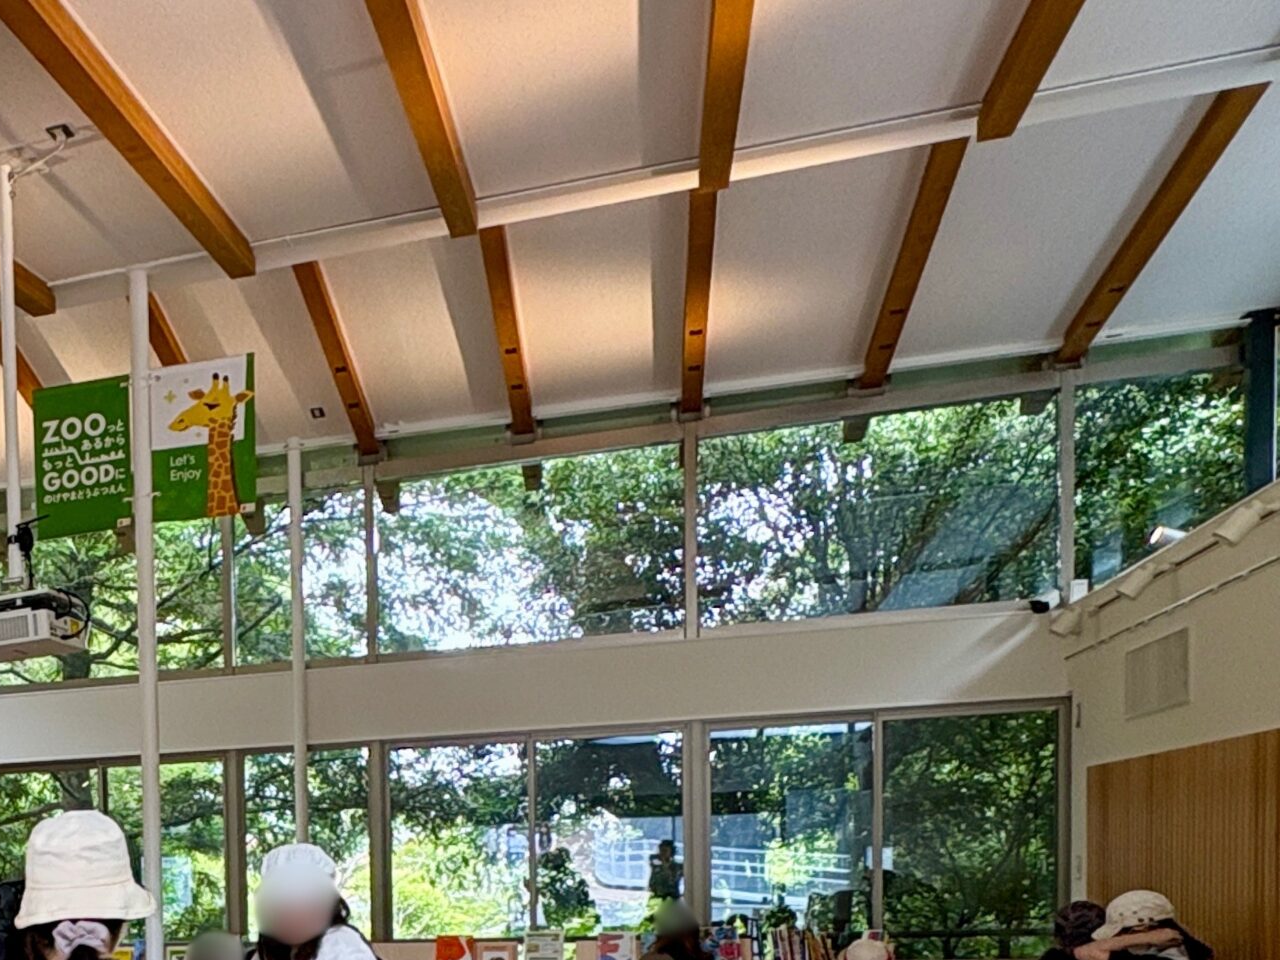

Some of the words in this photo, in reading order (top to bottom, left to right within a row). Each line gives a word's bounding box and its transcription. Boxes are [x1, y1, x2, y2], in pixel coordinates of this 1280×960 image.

[81, 433, 125, 451] あるから
[42, 455, 74, 471] もっと
[170, 453, 196, 467] Let's
[170, 467, 202, 483] Enjoy
